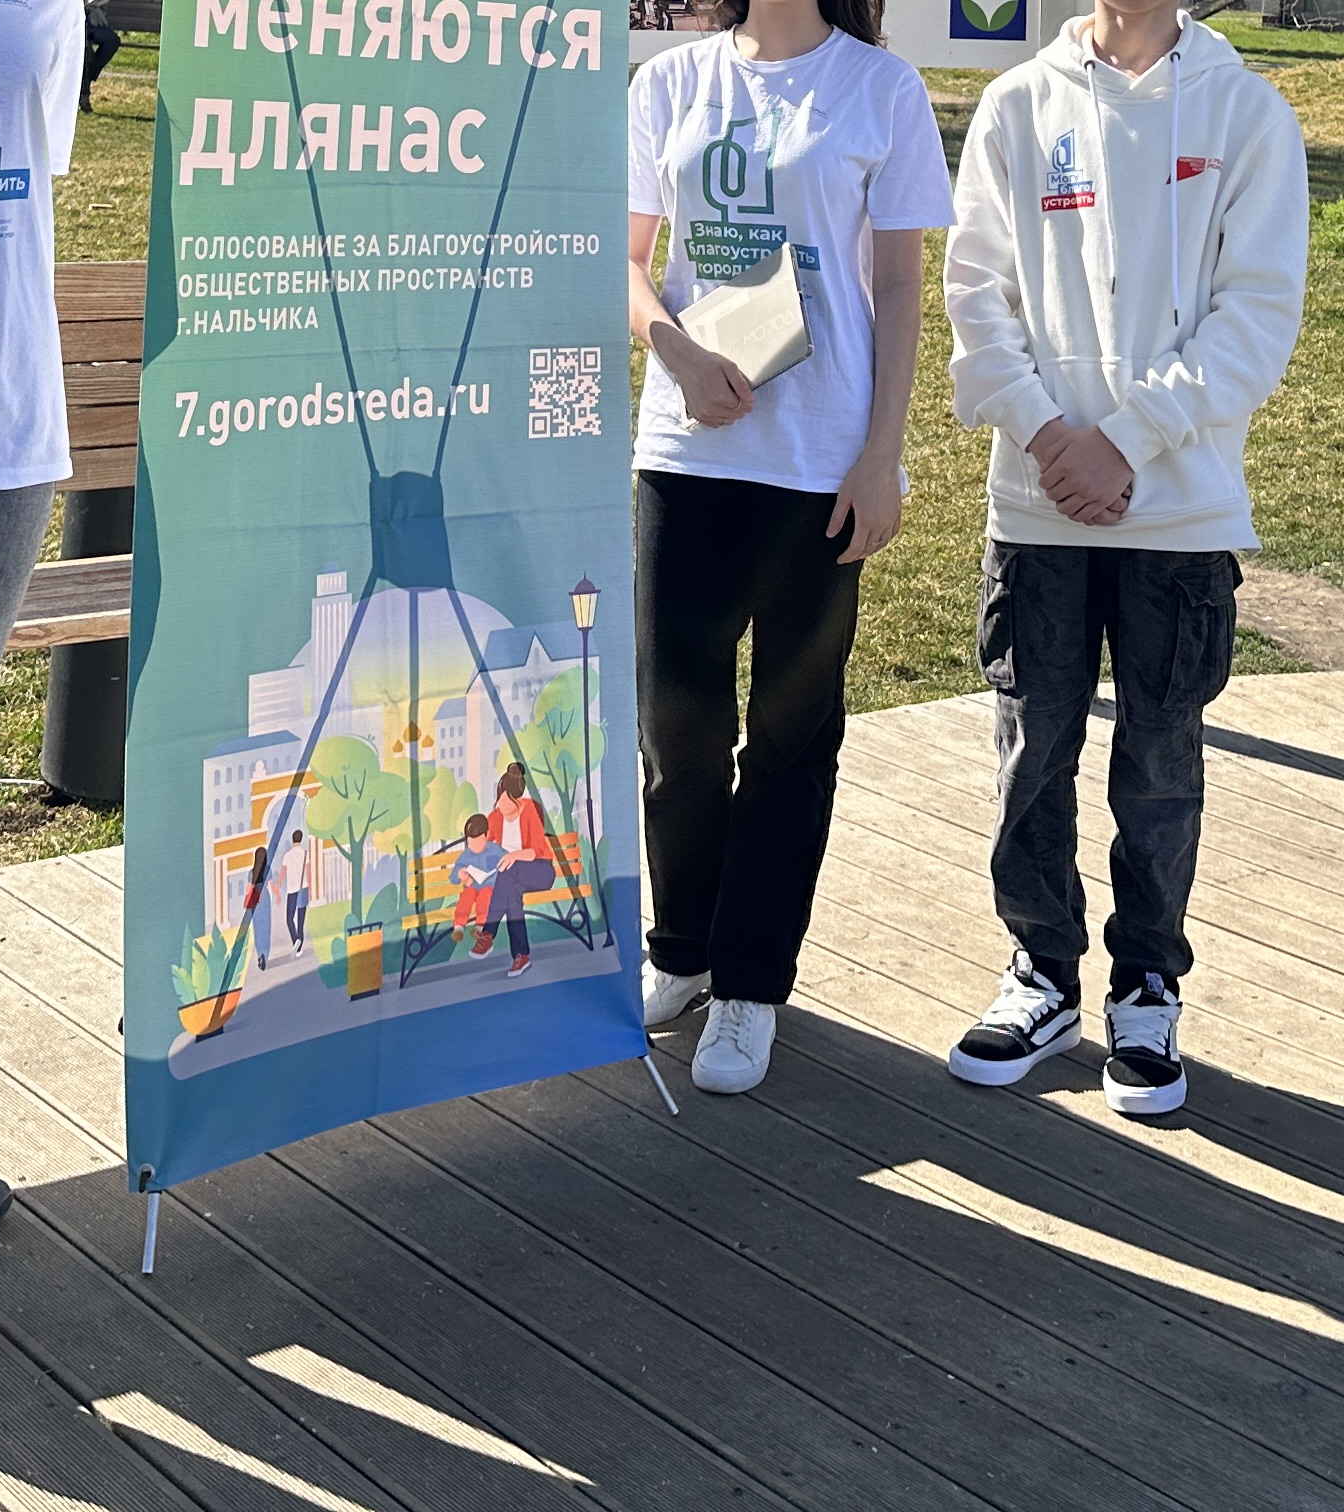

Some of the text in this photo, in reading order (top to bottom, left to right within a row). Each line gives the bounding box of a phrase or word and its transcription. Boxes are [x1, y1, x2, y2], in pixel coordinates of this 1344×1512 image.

[179, 98, 487, 186] длянас
[180, 229, 600, 260] ГОЛОСОВАНИЕ ЗА БЛАГОУСТРОЙСТВО
[695, 223, 783, 242] Знаю, как
[688, 240, 815, 264] благоустрть
[178, 267, 534, 300] ОБЩЕСТВЕННЫХ ПРОСТРАНСТВ
[176, 306, 319, 336] г.НАЛЬЧИКА
[175, 377, 490, 446] 7.gorodsreda.ru
